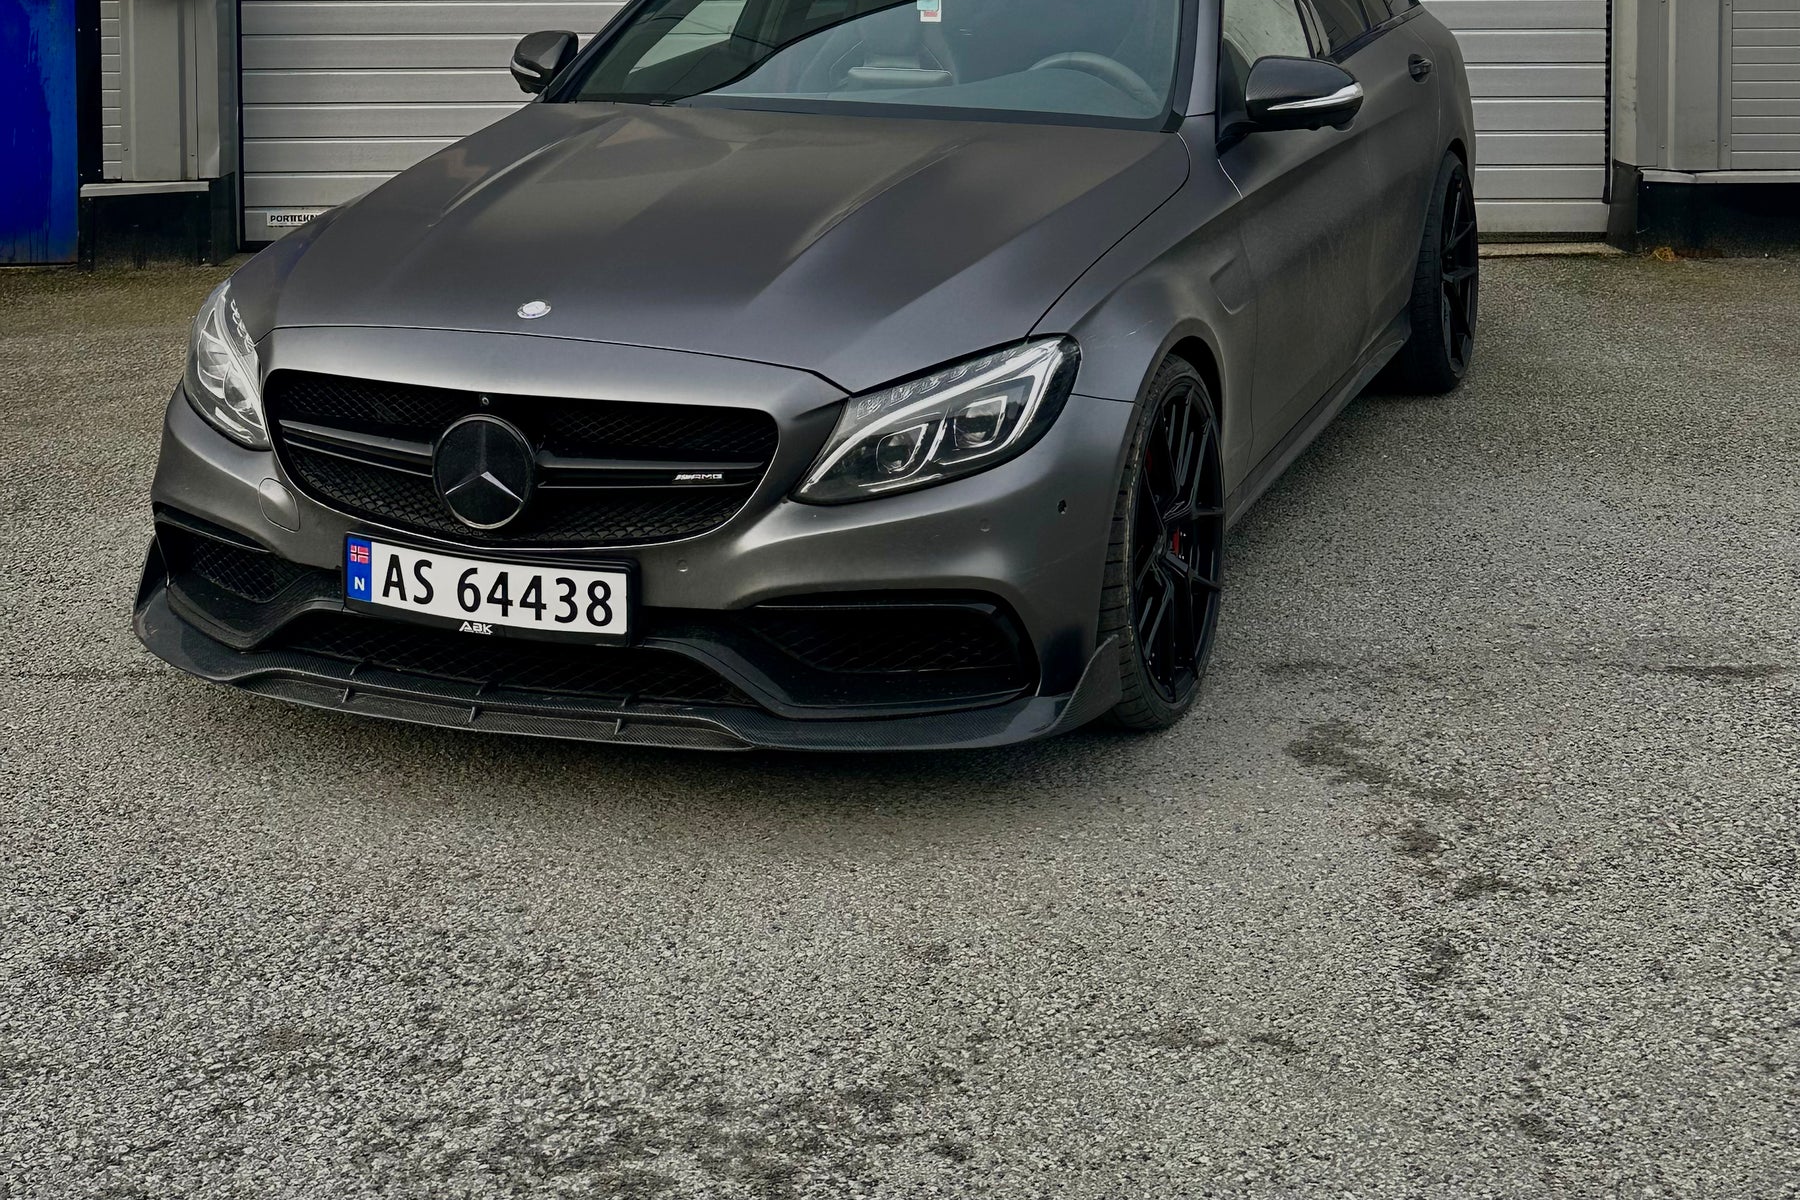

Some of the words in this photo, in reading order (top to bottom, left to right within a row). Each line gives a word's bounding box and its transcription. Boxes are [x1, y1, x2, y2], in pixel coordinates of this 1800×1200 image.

[354, 576, 365, 592] N
[382, 553, 434, 605] AS
[457, 567, 613, 627] 64438
[459, 621, 493, 634] ABK
